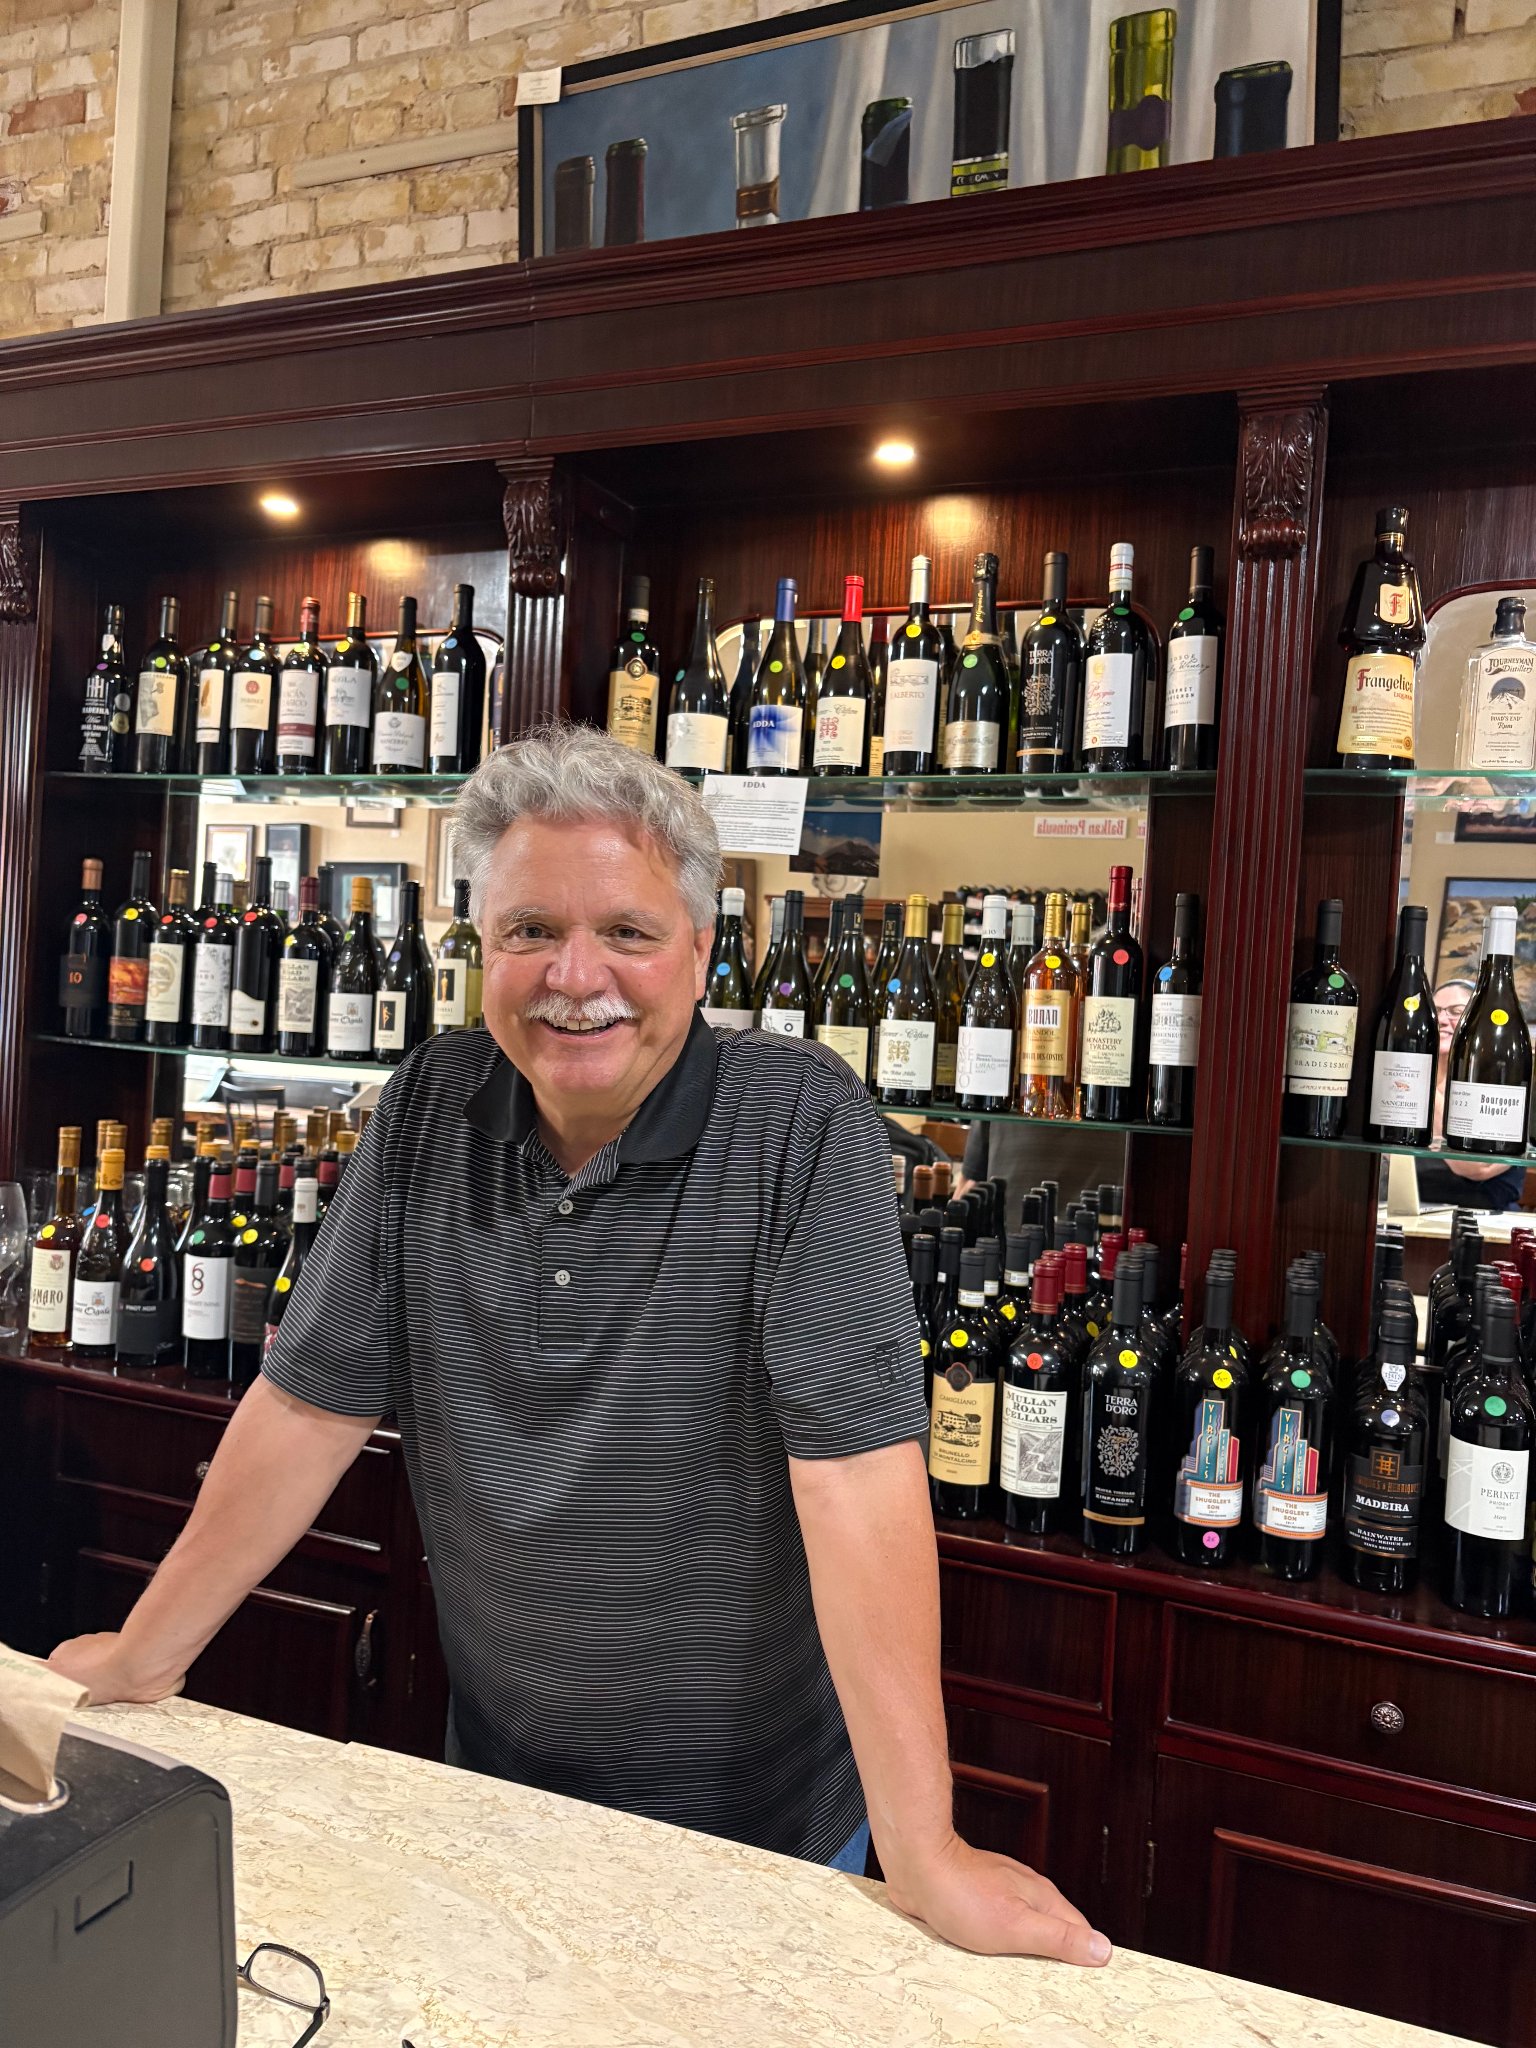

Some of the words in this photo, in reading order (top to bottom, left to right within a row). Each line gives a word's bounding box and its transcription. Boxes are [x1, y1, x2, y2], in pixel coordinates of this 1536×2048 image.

[1029, 650, 1054, 658] TERRA
[1029, 656, 1053, 665] D'ORO
[1484, 657, 1534, 673] JOURNEYMAN
[1502, 663, 1533, 674] Distillery
[1356, 667, 1413, 693] Frangelico
[1497, 721, 1513, 730] Rum
[742, 781, 766, 789] IDDA
[1028, 1008, 1058, 1026] BUNAN
[1310, 1008, 1339, 1016] INAMA
[1045, 1053, 1064, 1061] COSTES
[1383, 1070, 1421, 1079] CROCHET
[1380, 1099, 1419, 1109] SANCERRE
[1480, 1093, 1520, 1107] Bourgogne
[1479, 1104, 1508, 1116] Aligoté
[1006, 1390, 1057, 1407] MULLAN
[1104, 1394, 1138, 1407] TERRA
[1013, 1401, 1047, 1416] ROAD
[1105, 1403, 1138, 1416] D'ORO
[1005, 1407, 1058, 1424] CELLARS
[1203, 1403, 1215, 1479] VIRGIL'S
[938, 1447, 970, 1458] BRUNELLO
[1280, 1413, 1292, 1489] VIRGIL'S
[938, 1453, 977, 1464] MONTALCINO
[1095, 1494, 1135, 1504] ZINFANDEL
[1480, 1487, 1521, 1500] PERINET
[1355, 1494, 1410, 1512] MADEIRA
[1272, 1506, 1310, 1517] SMUGGLER'S
[1356, 1528, 1404, 1543] RAINWATER
